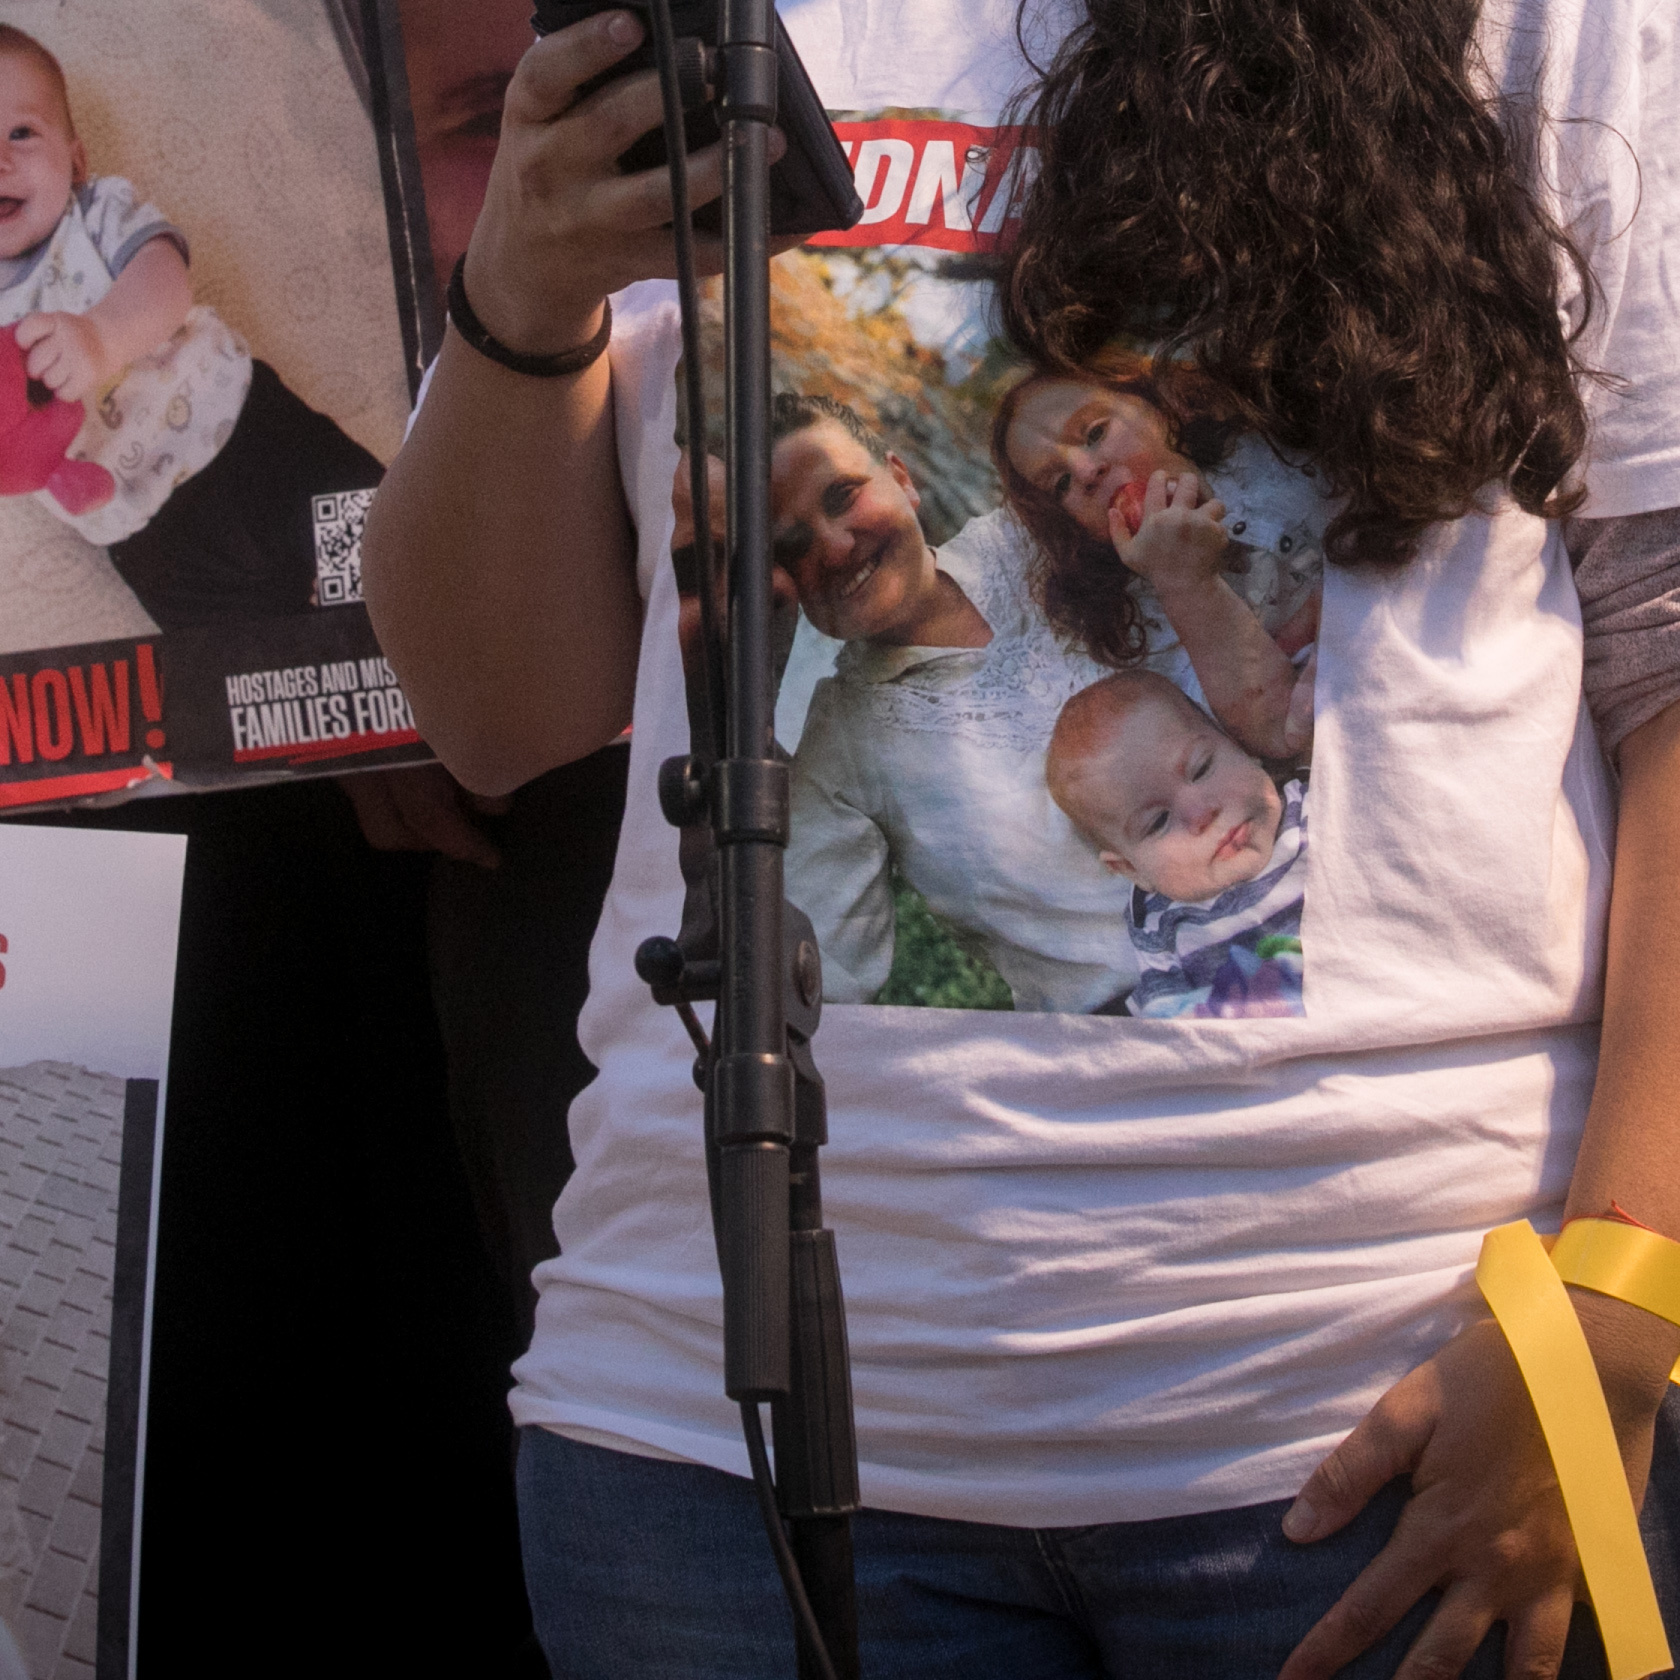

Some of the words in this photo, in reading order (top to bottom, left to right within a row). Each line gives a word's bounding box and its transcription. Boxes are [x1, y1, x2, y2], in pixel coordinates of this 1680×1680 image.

[225, 665, 319, 707] HOSTAGES
[321, 660, 360, 694] AND
[230, 693, 352, 751] FAMILIES
[353, 687, 417, 736] FOR
